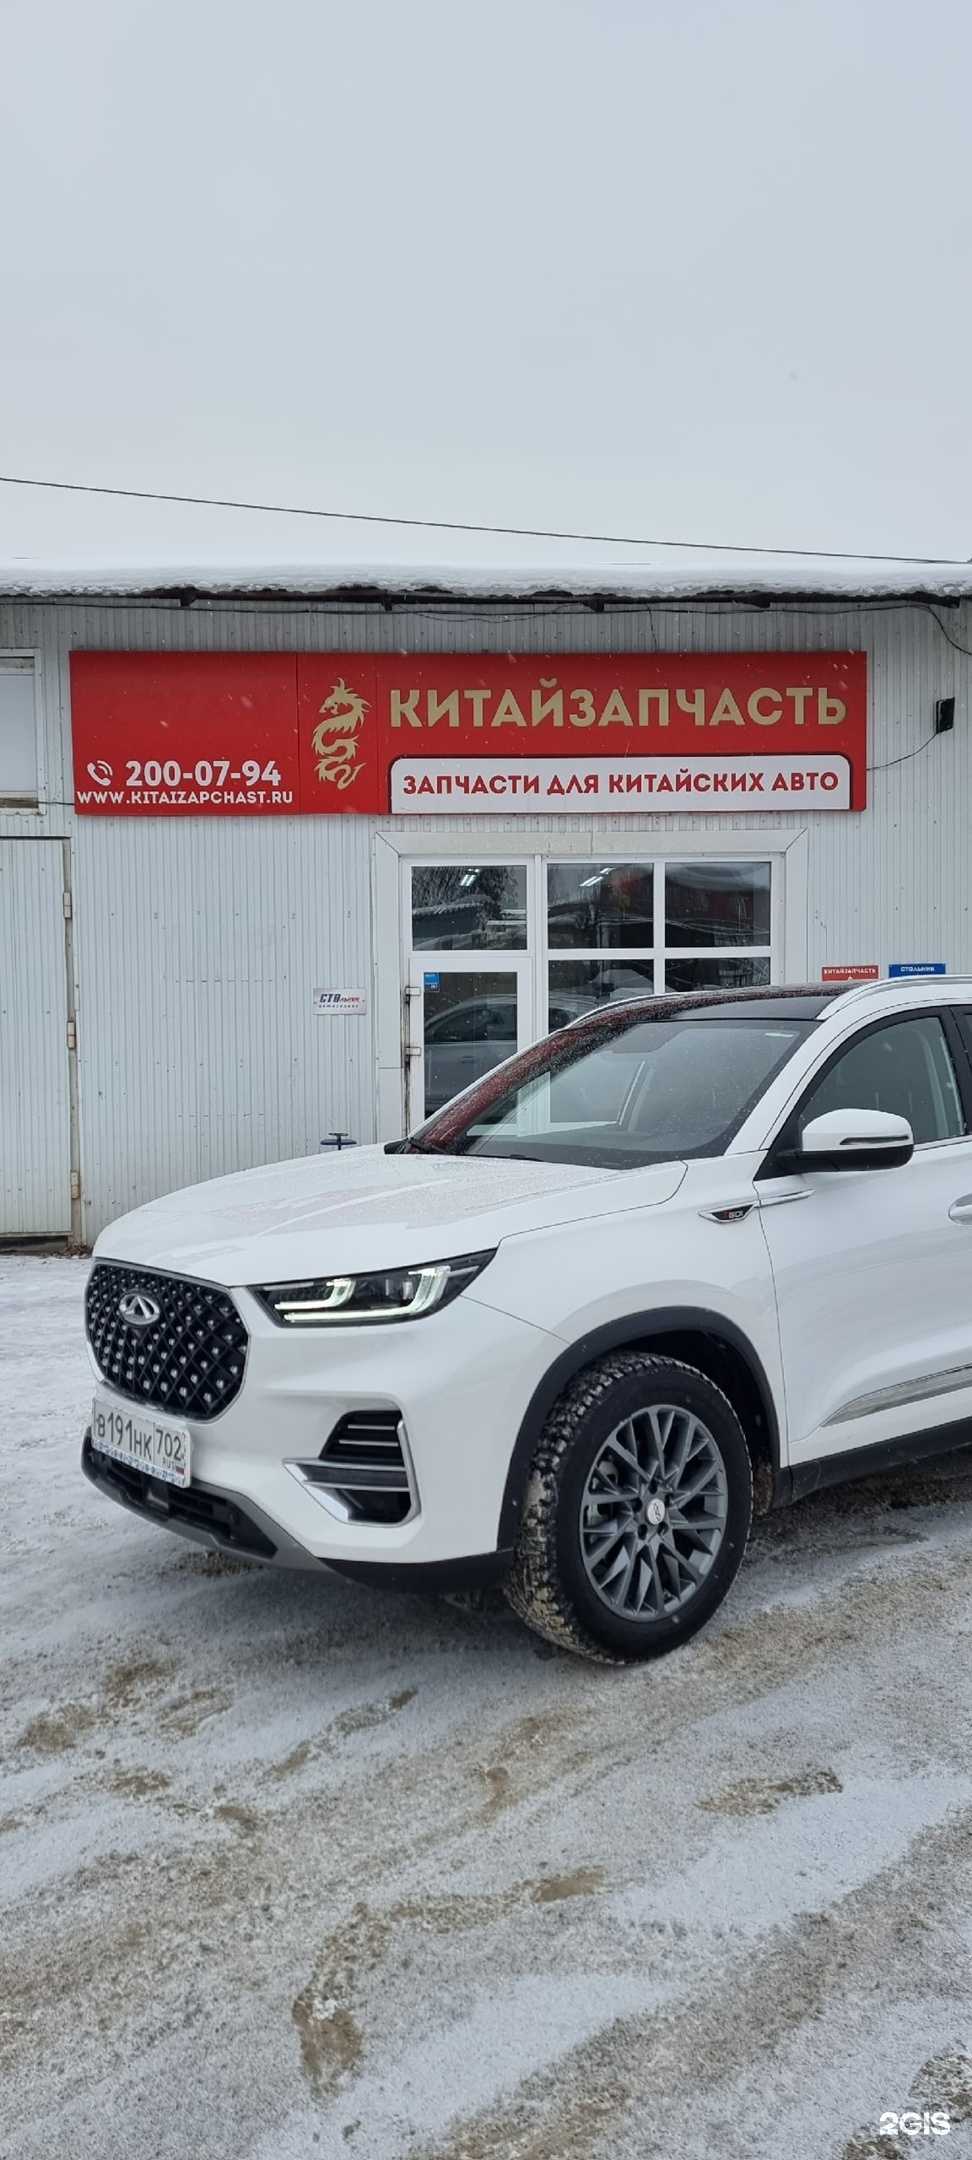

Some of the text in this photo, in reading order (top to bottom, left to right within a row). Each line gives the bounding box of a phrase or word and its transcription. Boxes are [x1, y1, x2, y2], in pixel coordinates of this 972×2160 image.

[389, 677, 847, 728] КИТАЙЗАПЧАСТЬ
[125, 760, 282, 787] 200-07-94
[403, 769, 840, 796] ЗАПЧАСТИ ДЛЯ КИТАЙСКИХ АВТО
[76, 790, 294, 805] WWW.KITAIZAPCHAST.RU
[155, 1428, 181, 1461] 702
